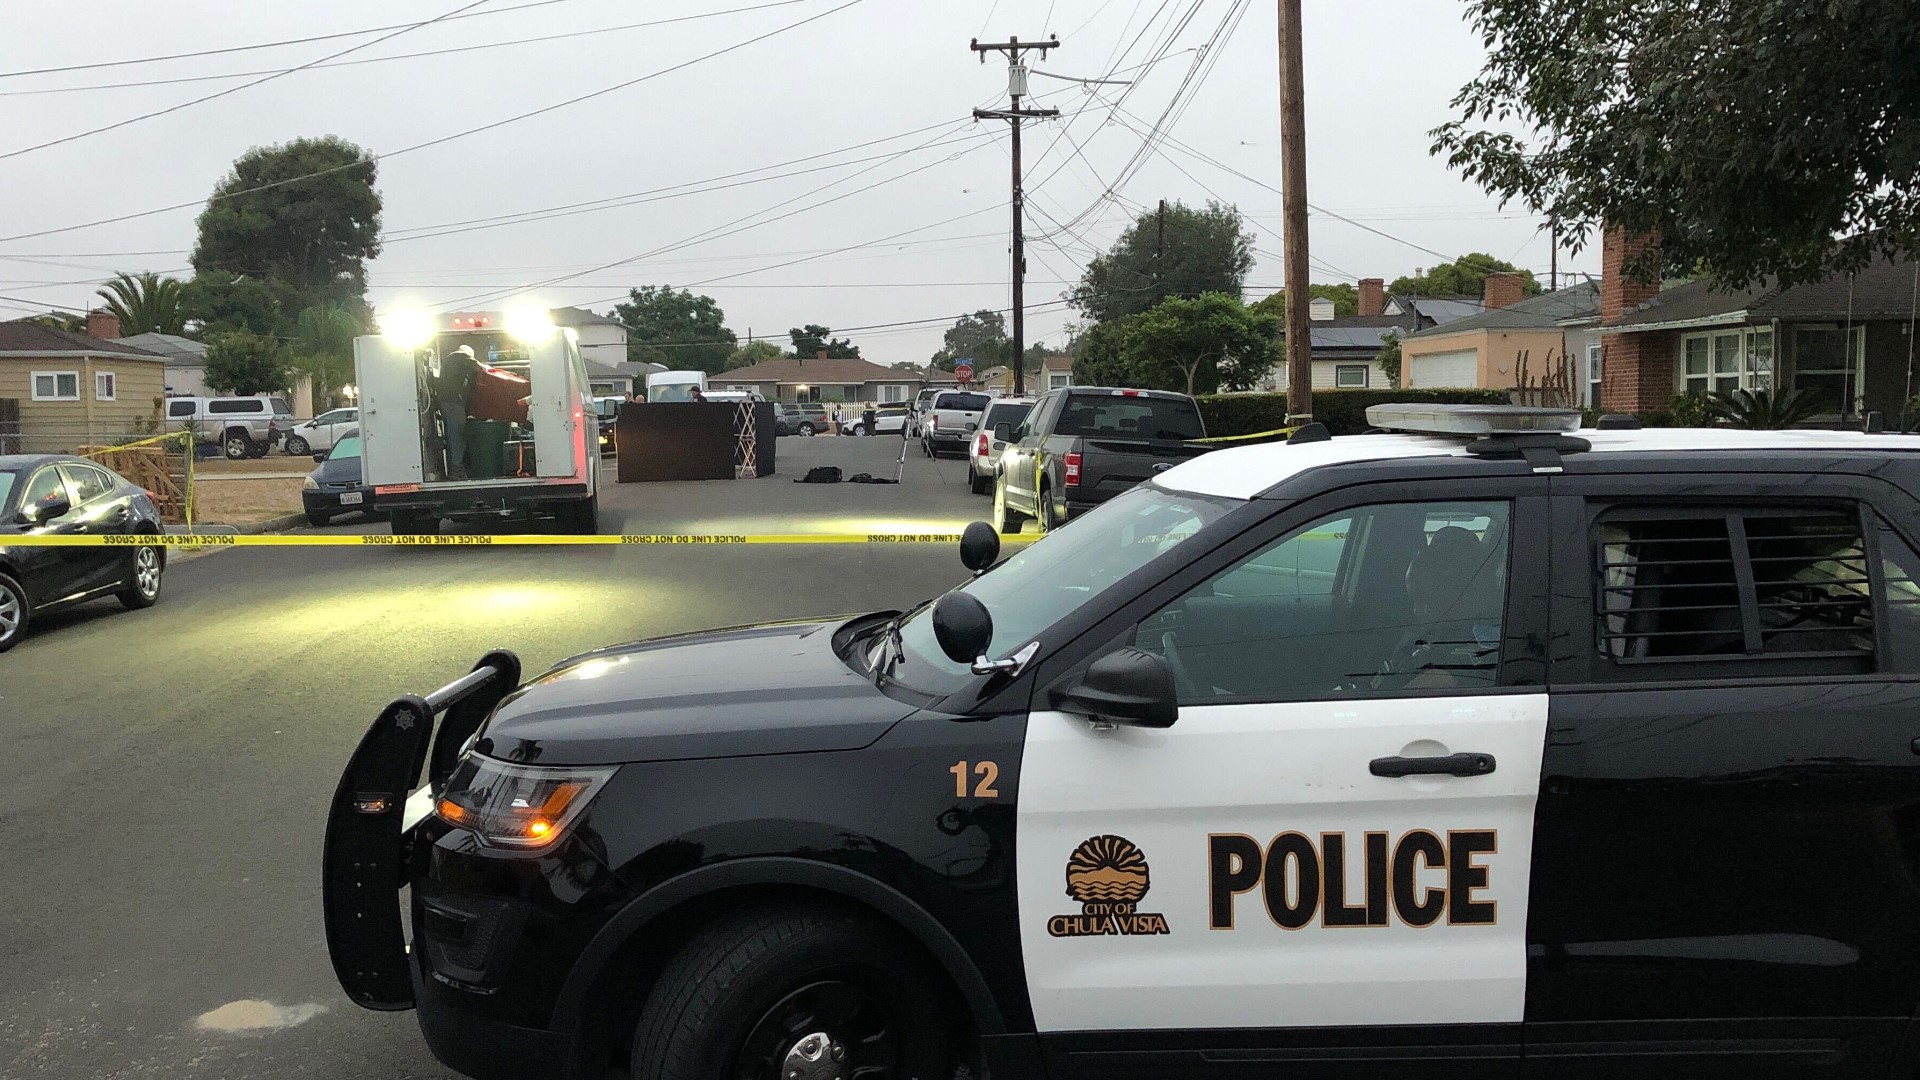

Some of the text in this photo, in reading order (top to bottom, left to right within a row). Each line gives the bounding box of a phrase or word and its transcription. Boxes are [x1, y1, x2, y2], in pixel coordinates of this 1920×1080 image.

[956, 370, 972, 378] STOP
[104, 535, 235, 544] POLICE LINE DO NOT CROSS
[362, 535, 492, 544] POLICE LINE DO NOT CROSS
[620, 535, 746, 543] POLICE LINE DO NOT CROSS
[867, 534, 896, 542] CROSS
[898, 534, 916, 542] NOT
[918, 534, 930, 542] DO
[933, 534, 953, 542] LINE
[949, 760, 999, 797] 12
[1207, 829, 1499, 931] POLICE
[1084, 903, 1134, 914] CITY OF
[1050, 916, 1167, 934] CHULA VISTA
